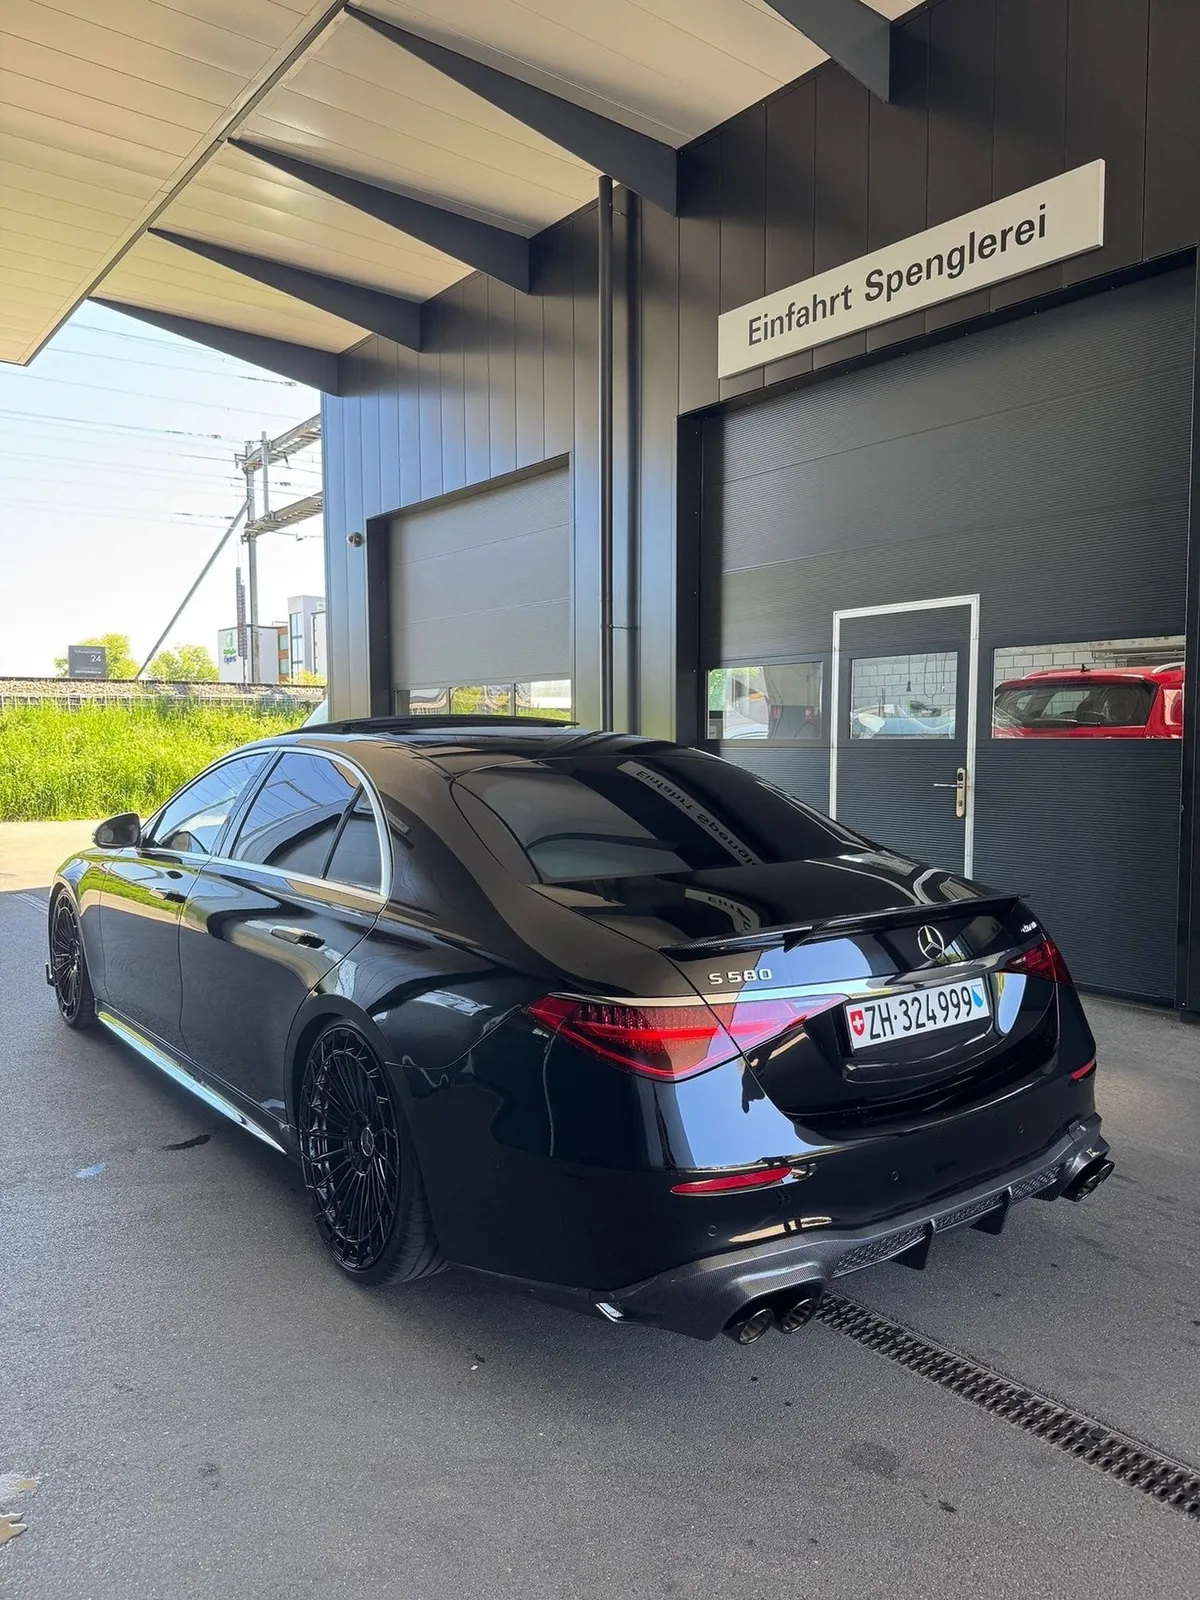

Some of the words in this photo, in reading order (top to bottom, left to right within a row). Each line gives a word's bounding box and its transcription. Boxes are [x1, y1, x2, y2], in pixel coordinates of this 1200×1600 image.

[748, 285, 852, 346] Einfahrt
[864, 203, 1047, 302] Spenglerei
[91, 654, 101, 662] 24
[708, 972, 723, 985] S
[727, 968, 773, 983] 580
